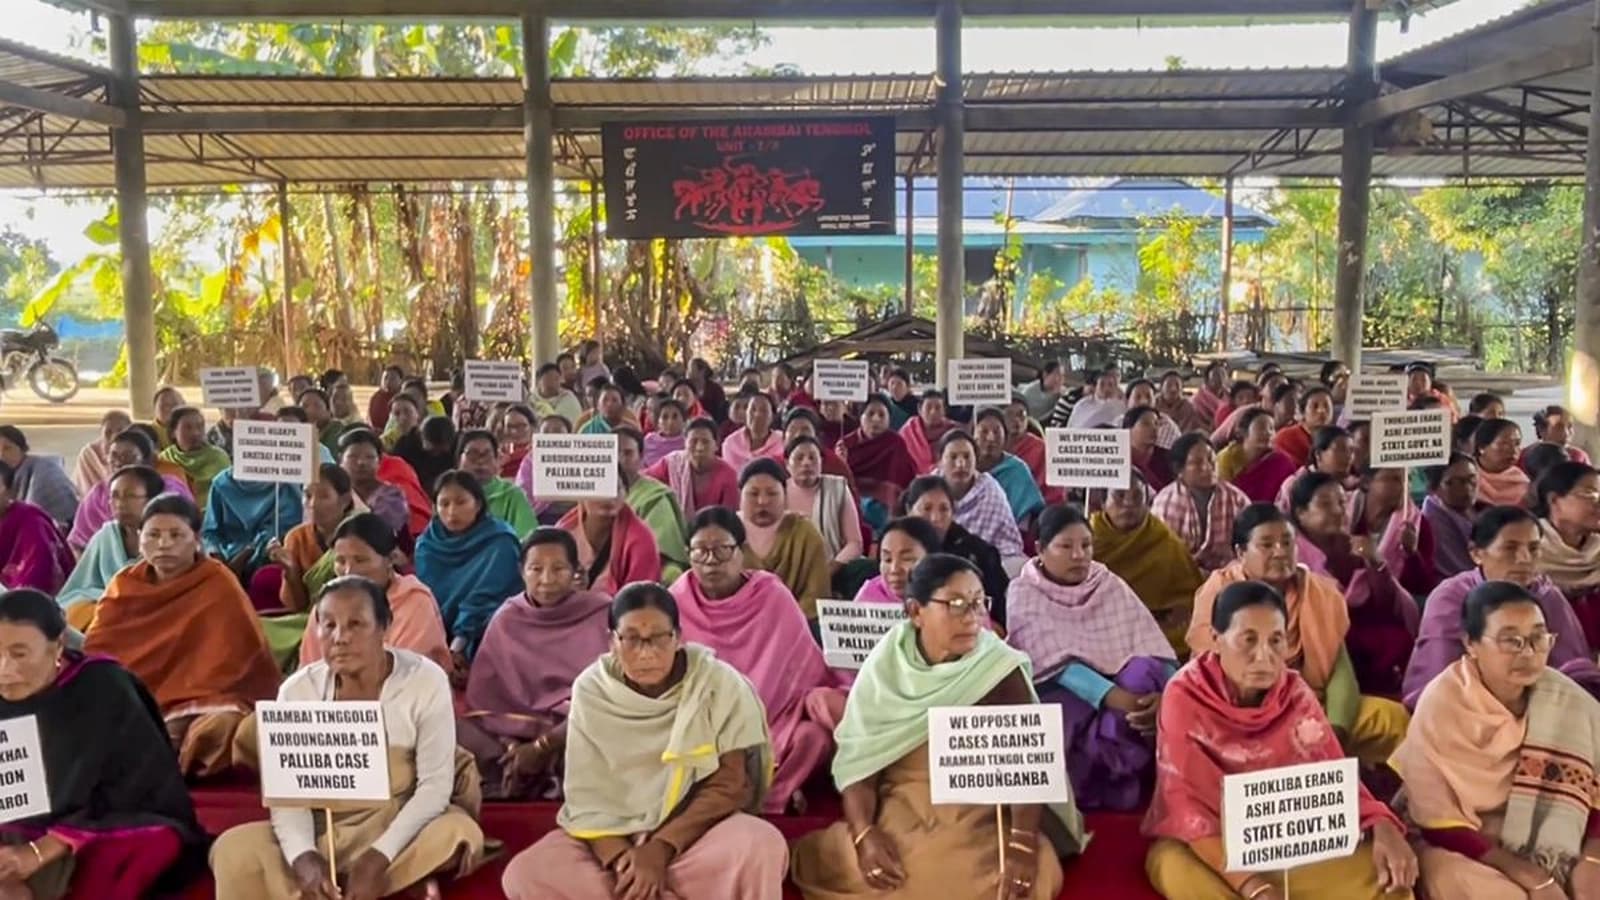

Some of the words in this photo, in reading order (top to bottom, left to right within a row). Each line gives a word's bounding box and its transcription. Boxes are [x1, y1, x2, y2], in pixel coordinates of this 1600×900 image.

[624, 126, 675, 140] OFFICE
[679, 125, 697, 138] OF
[703, 124, 729, 138] THE
[1073, 434, 1101, 442] OPPOSE
[1381, 441, 1405, 450] STATE
[1432, 439, 1442, 447] NA
[1058, 446, 1083, 454] CASES
[1085, 446, 1120, 454] AGAINST
[545, 467, 581, 477] PALLIBA
[583, 467, 606, 478] CASE
[822, 607, 867, 617] ARAMBAI
[838, 638, 877, 650] PALLIB
[262, 710, 312, 723] ARAMBAI
[315, 710, 378, 723] TENGGOLGI
[949, 716, 968, 729] WE
[971, 714, 1018, 728] OPPOSE
[1020, 713, 1042, 727] NIA
[270, 732, 379, 746] KOROUNGANBA-DA
[949, 734, 989, 750] CASES
[992, 732, 1045, 748] AGAINST
[280, 753, 332, 769] PALLIBA
[336, 753, 370, 769] CASE
[939, 755, 985, 767] ARAMBAI
[988, 753, 1024, 765] TENGOL
[1027, 752, 1055, 764] CHIEF
[296, 774, 356, 789] YANINGDE
[1243, 776, 1302, 797] THOKLIBA
[1305, 770, 1344, 788] ERANG
[1246, 801, 1275, 819] ASHI
[1278, 790, 1344, 814] ATHUBADA
[1243, 823, 1282, 844] STATE
[1286, 816, 1325, 837] GOVT.
[1328, 813, 1346, 830] NA
[1242, 834, 1349, 866] LOISINGADABANI
